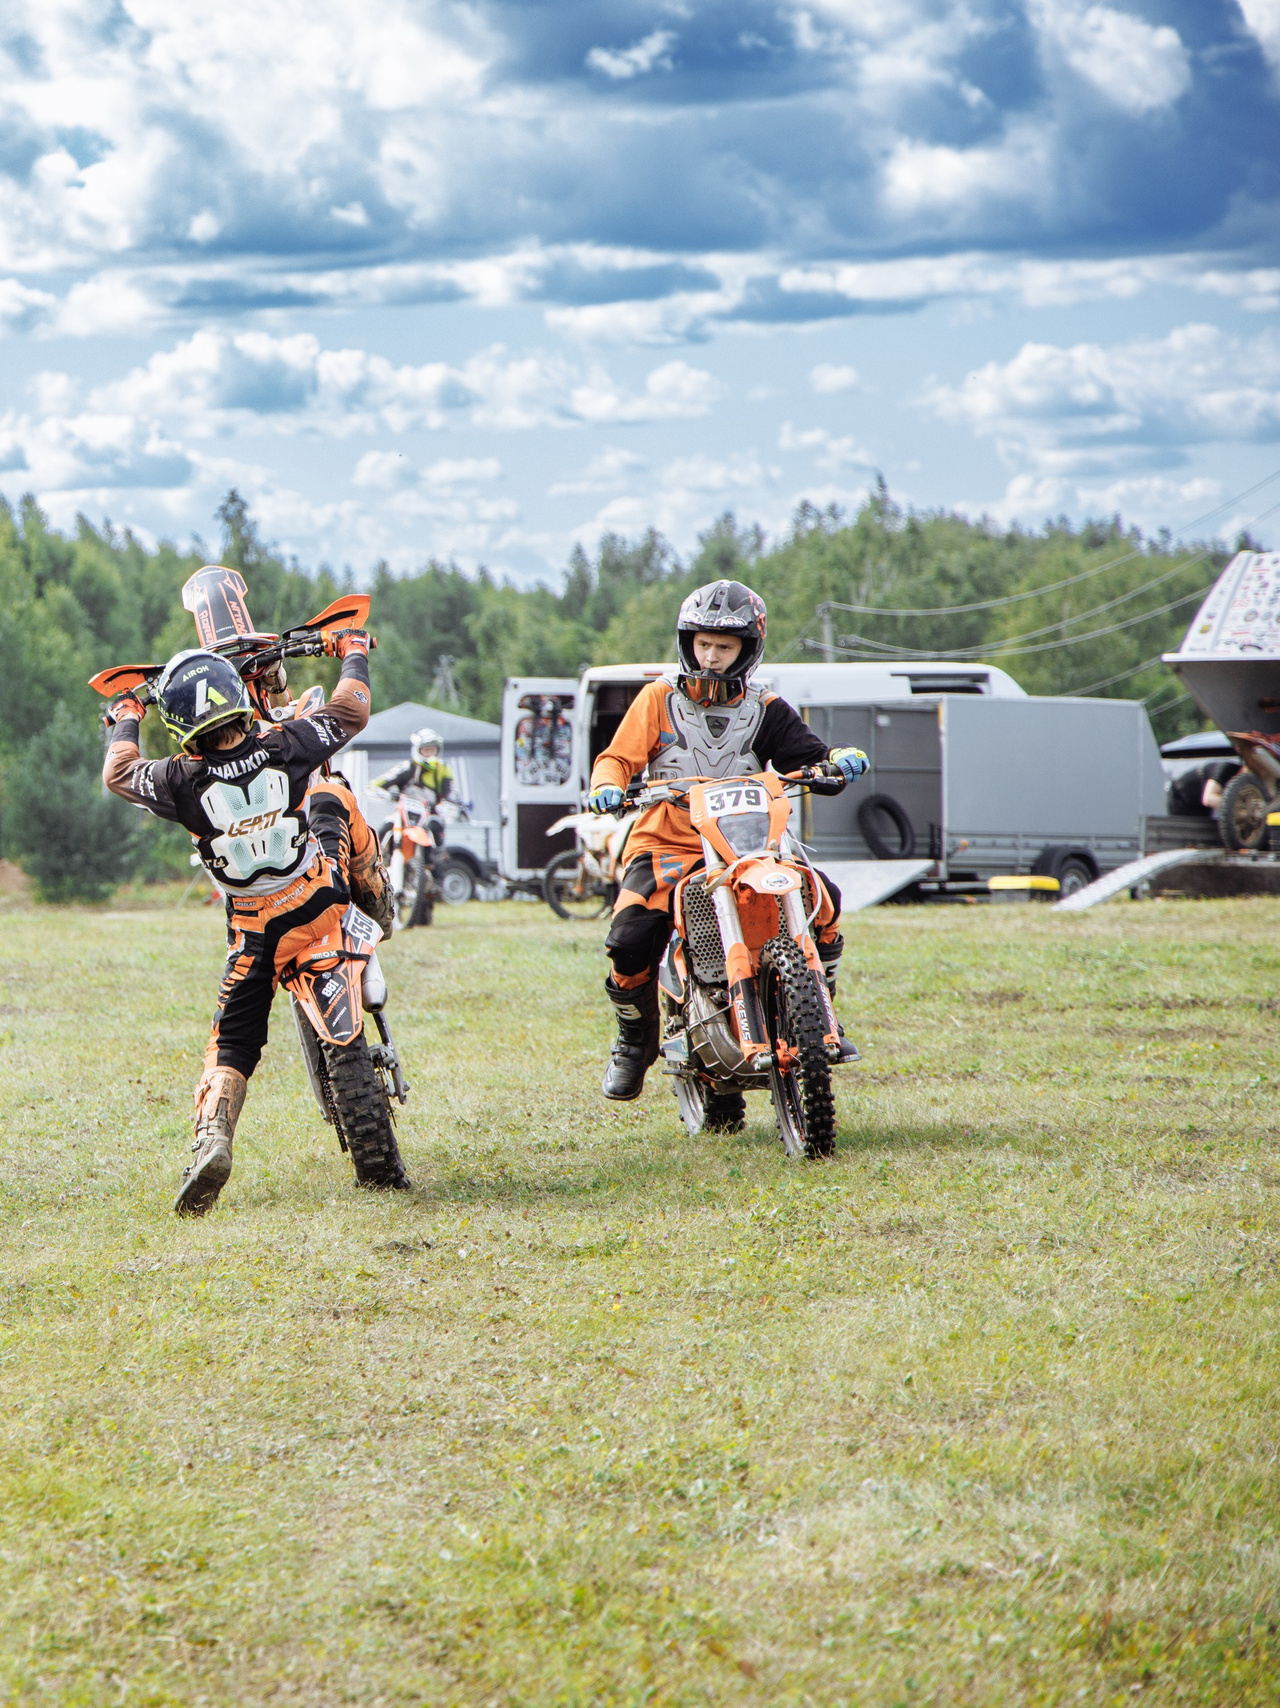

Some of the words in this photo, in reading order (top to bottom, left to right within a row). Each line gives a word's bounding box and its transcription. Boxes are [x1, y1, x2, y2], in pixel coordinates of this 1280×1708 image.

[182, 665, 210, 682] AIROH
[709, 789, 761, 811] 379
[227, 808, 282, 838] LEATT
[350, 910, 374, 941] 350
[321, 979, 340, 998] 881
[734, 999, 752, 1042] KEWS
